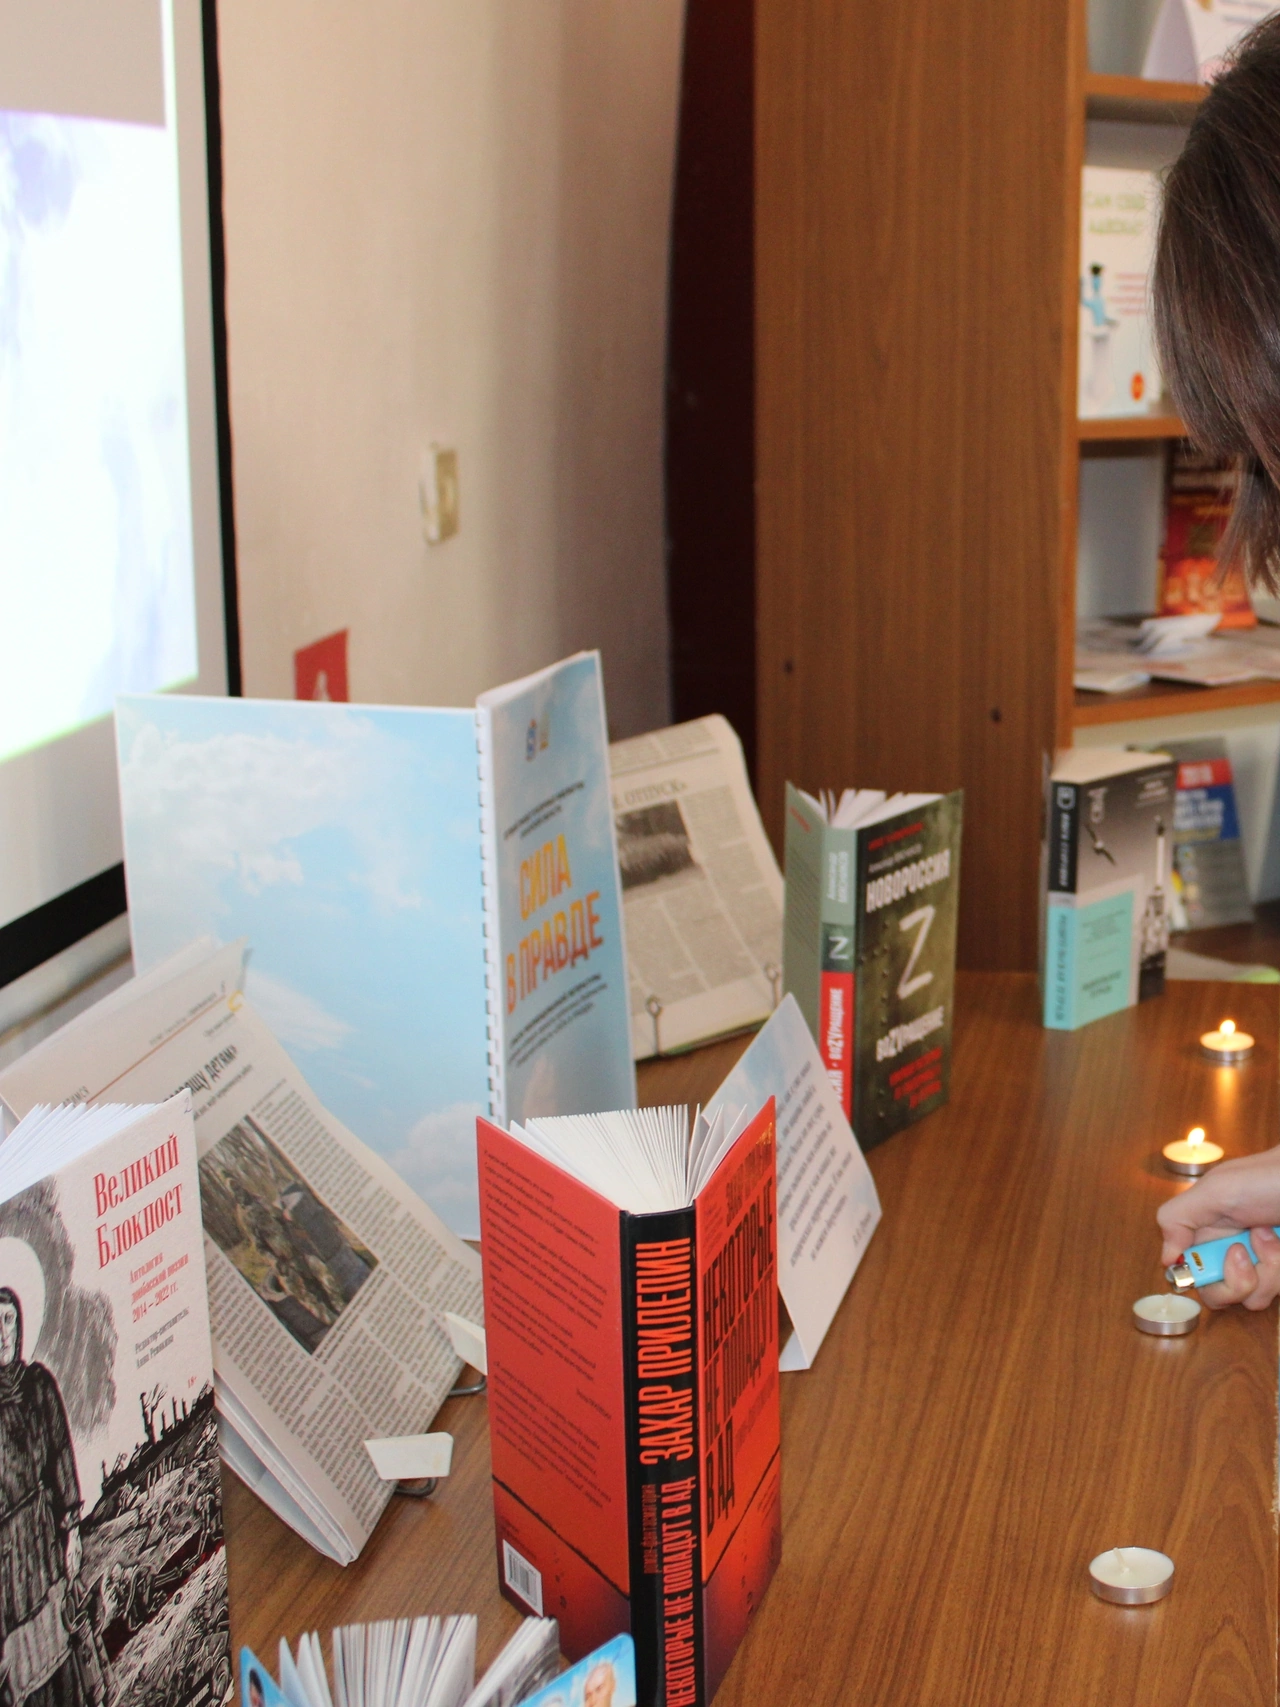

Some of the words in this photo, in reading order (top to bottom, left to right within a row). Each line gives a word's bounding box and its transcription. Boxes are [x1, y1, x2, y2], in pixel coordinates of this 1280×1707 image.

[519, 833, 572, 920] СИЛА
[866, 849, 950, 914] НОВОРОССИЯ
[506, 953, 517, 1016] В
[519, 887, 604, 1001] ПРАВДЕ
[93, 1132, 180, 1218] Великий
[96, 1183, 183, 1270] Блокпост
[635, 1237, 691, 1379] ПРИЛЕПИН
[703, 1176, 773, 1373] НЕКОТОРЫЕ
[638, 1383, 693, 1466] ЗАХАР
[661, 1476, 696, 1499] АД
[662, 1501, 687, 1521] В
[661, 1520, 697, 1594] ПОПАДУТ
[664, 1591, 694, 1617] НЕ
[664, 1614, 696, 1707] НЕКОТОРЫЕ
